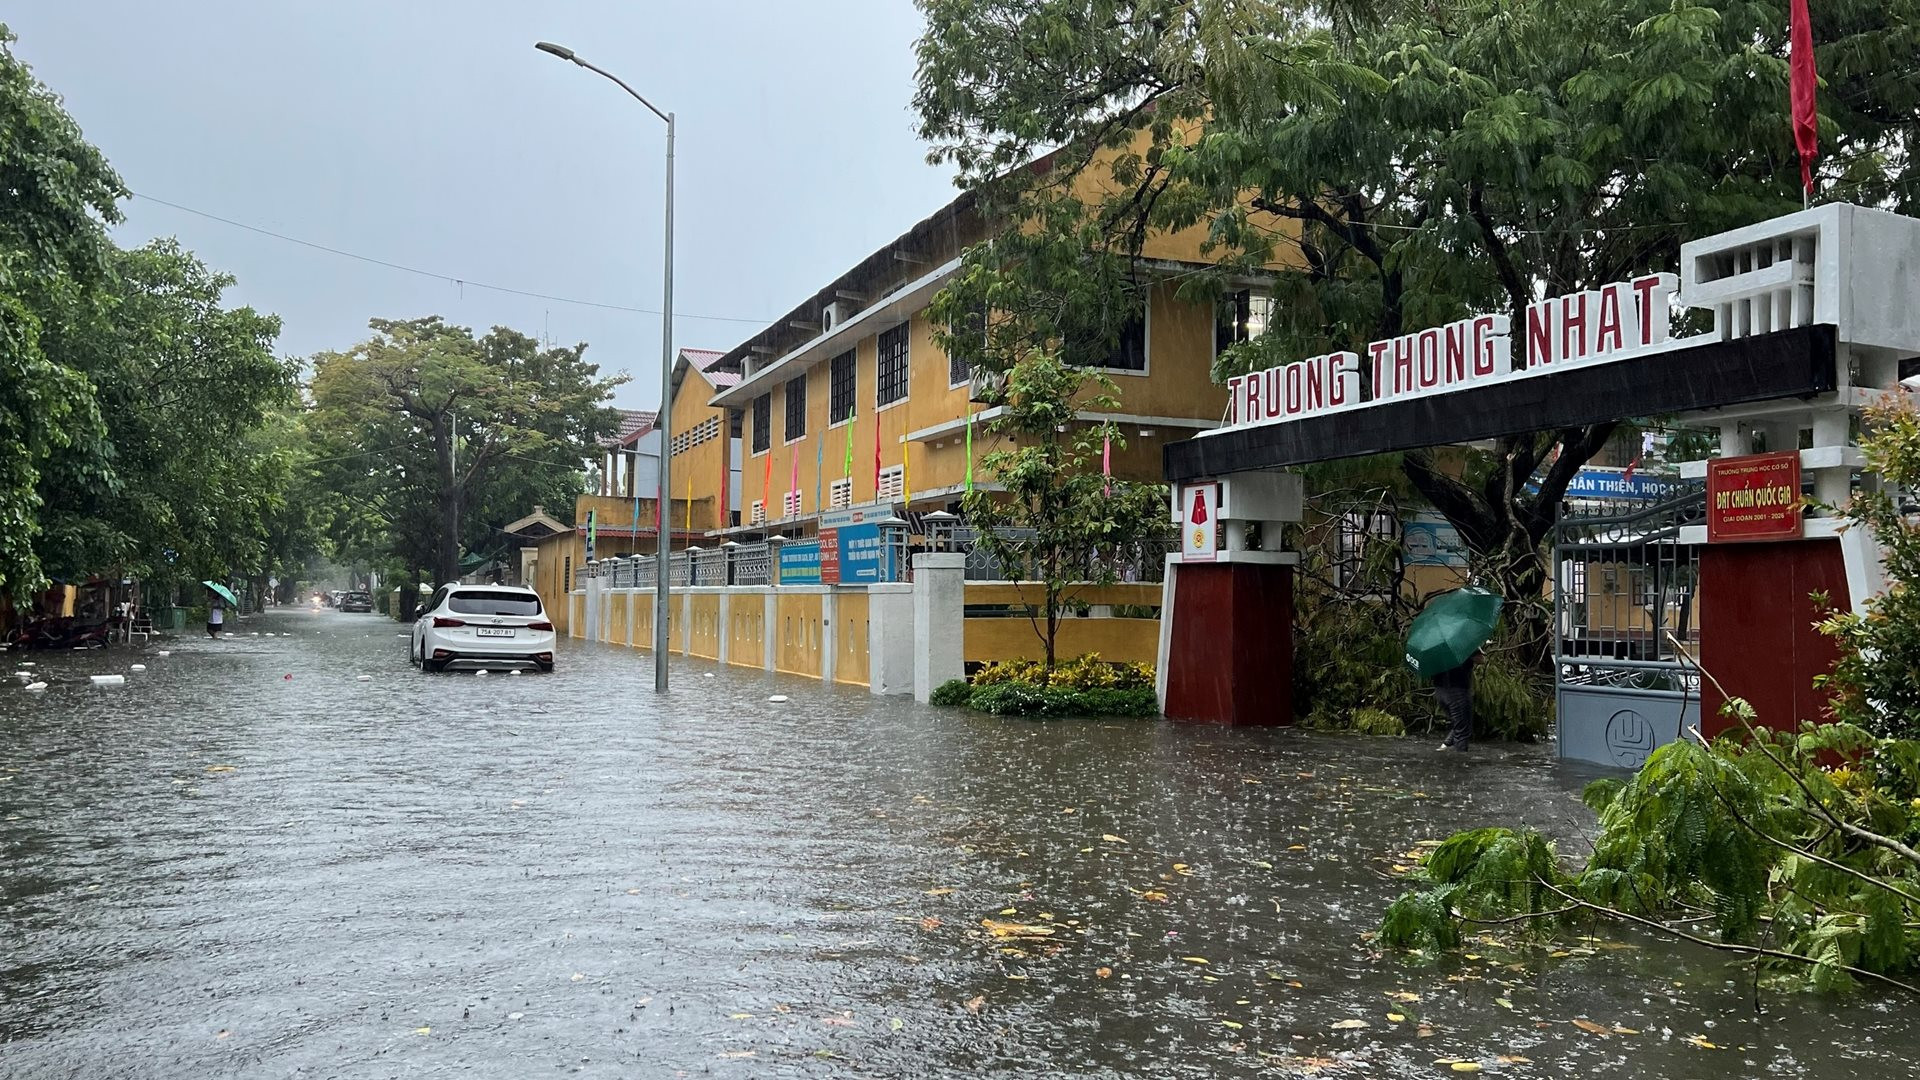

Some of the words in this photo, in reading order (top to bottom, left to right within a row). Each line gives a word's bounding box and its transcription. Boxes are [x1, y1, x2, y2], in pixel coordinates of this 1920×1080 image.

[1228, 352, 1347, 425] TRUONG
[1369, 315, 1495, 400] THONG
[1527, 275, 1661, 367] NHAT
[1566, 476, 1595, 491] HÂN
[1716, 490, 1730, 514] ĐẠT
[1755, 479, 1777, 509] QUỐC
[1777, 485, 1791, 505] GIA
[1722, 515, 1735, 523] GIAI
